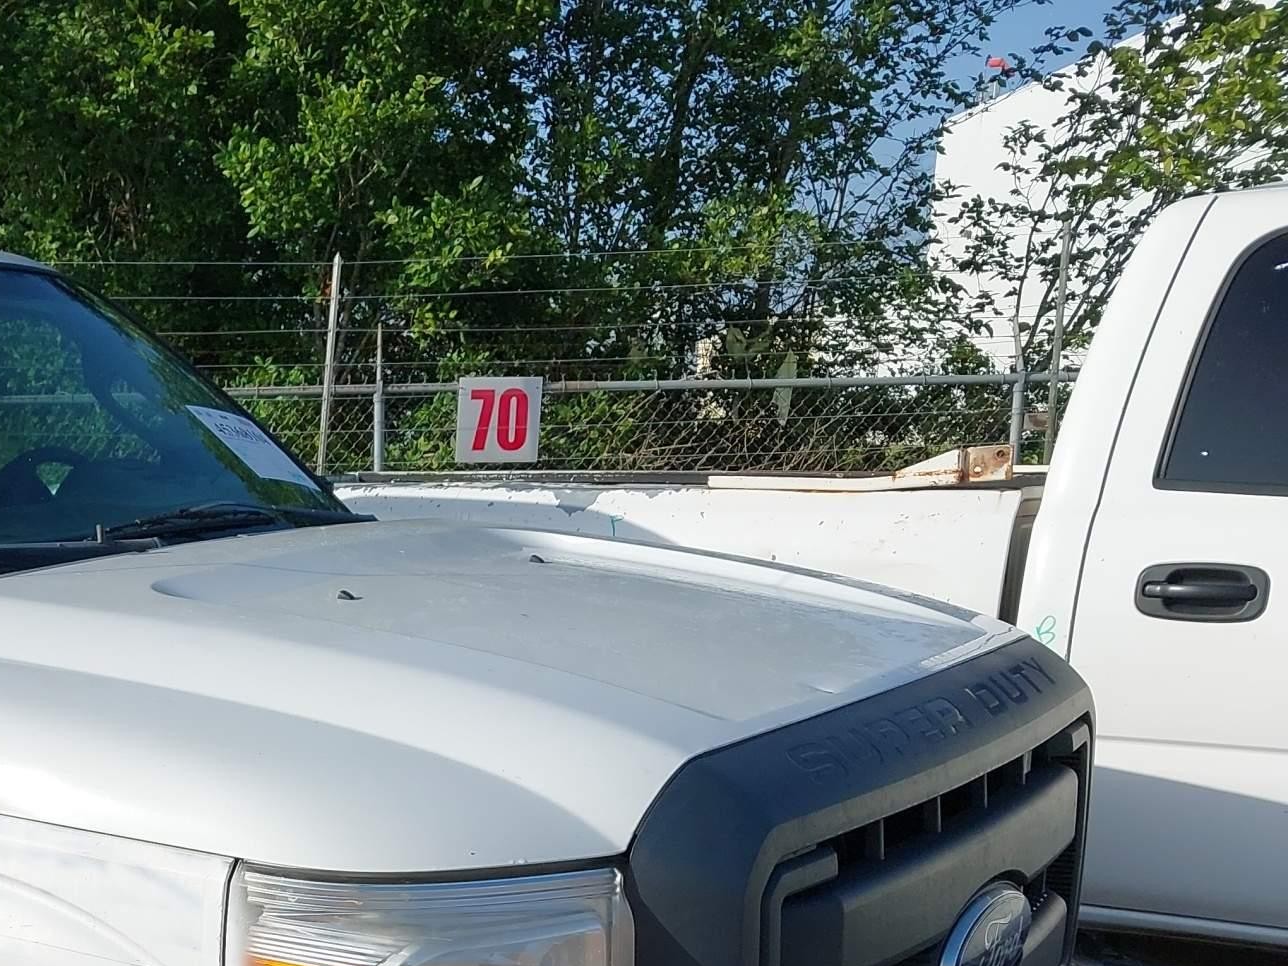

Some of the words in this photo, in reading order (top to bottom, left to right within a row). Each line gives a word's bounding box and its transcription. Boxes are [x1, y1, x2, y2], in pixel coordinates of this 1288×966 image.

[470, 387, 529, 451] 70
[784, 696, 974, 780] SUPER
[963, 656, 1057, 715] DUTY
